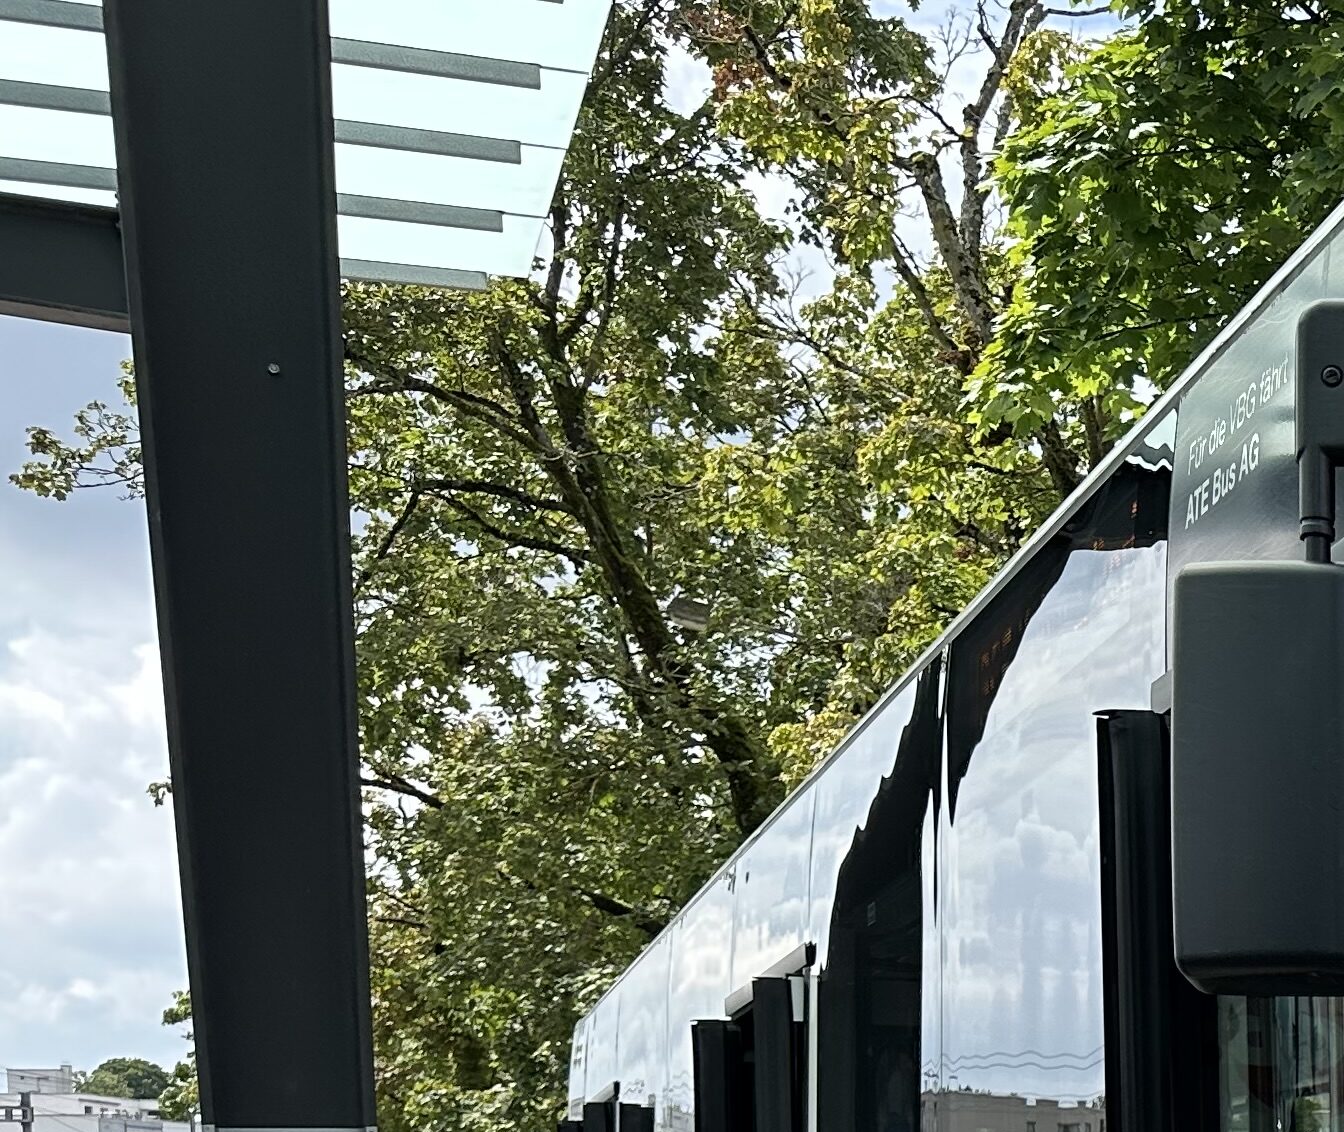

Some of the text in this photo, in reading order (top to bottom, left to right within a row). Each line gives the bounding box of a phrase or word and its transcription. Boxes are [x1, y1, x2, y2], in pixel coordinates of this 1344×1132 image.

[1187, 352, 1289, 476] Für die VBG fährt
[1184, 432, 1260, 530] ATE Bus AG
